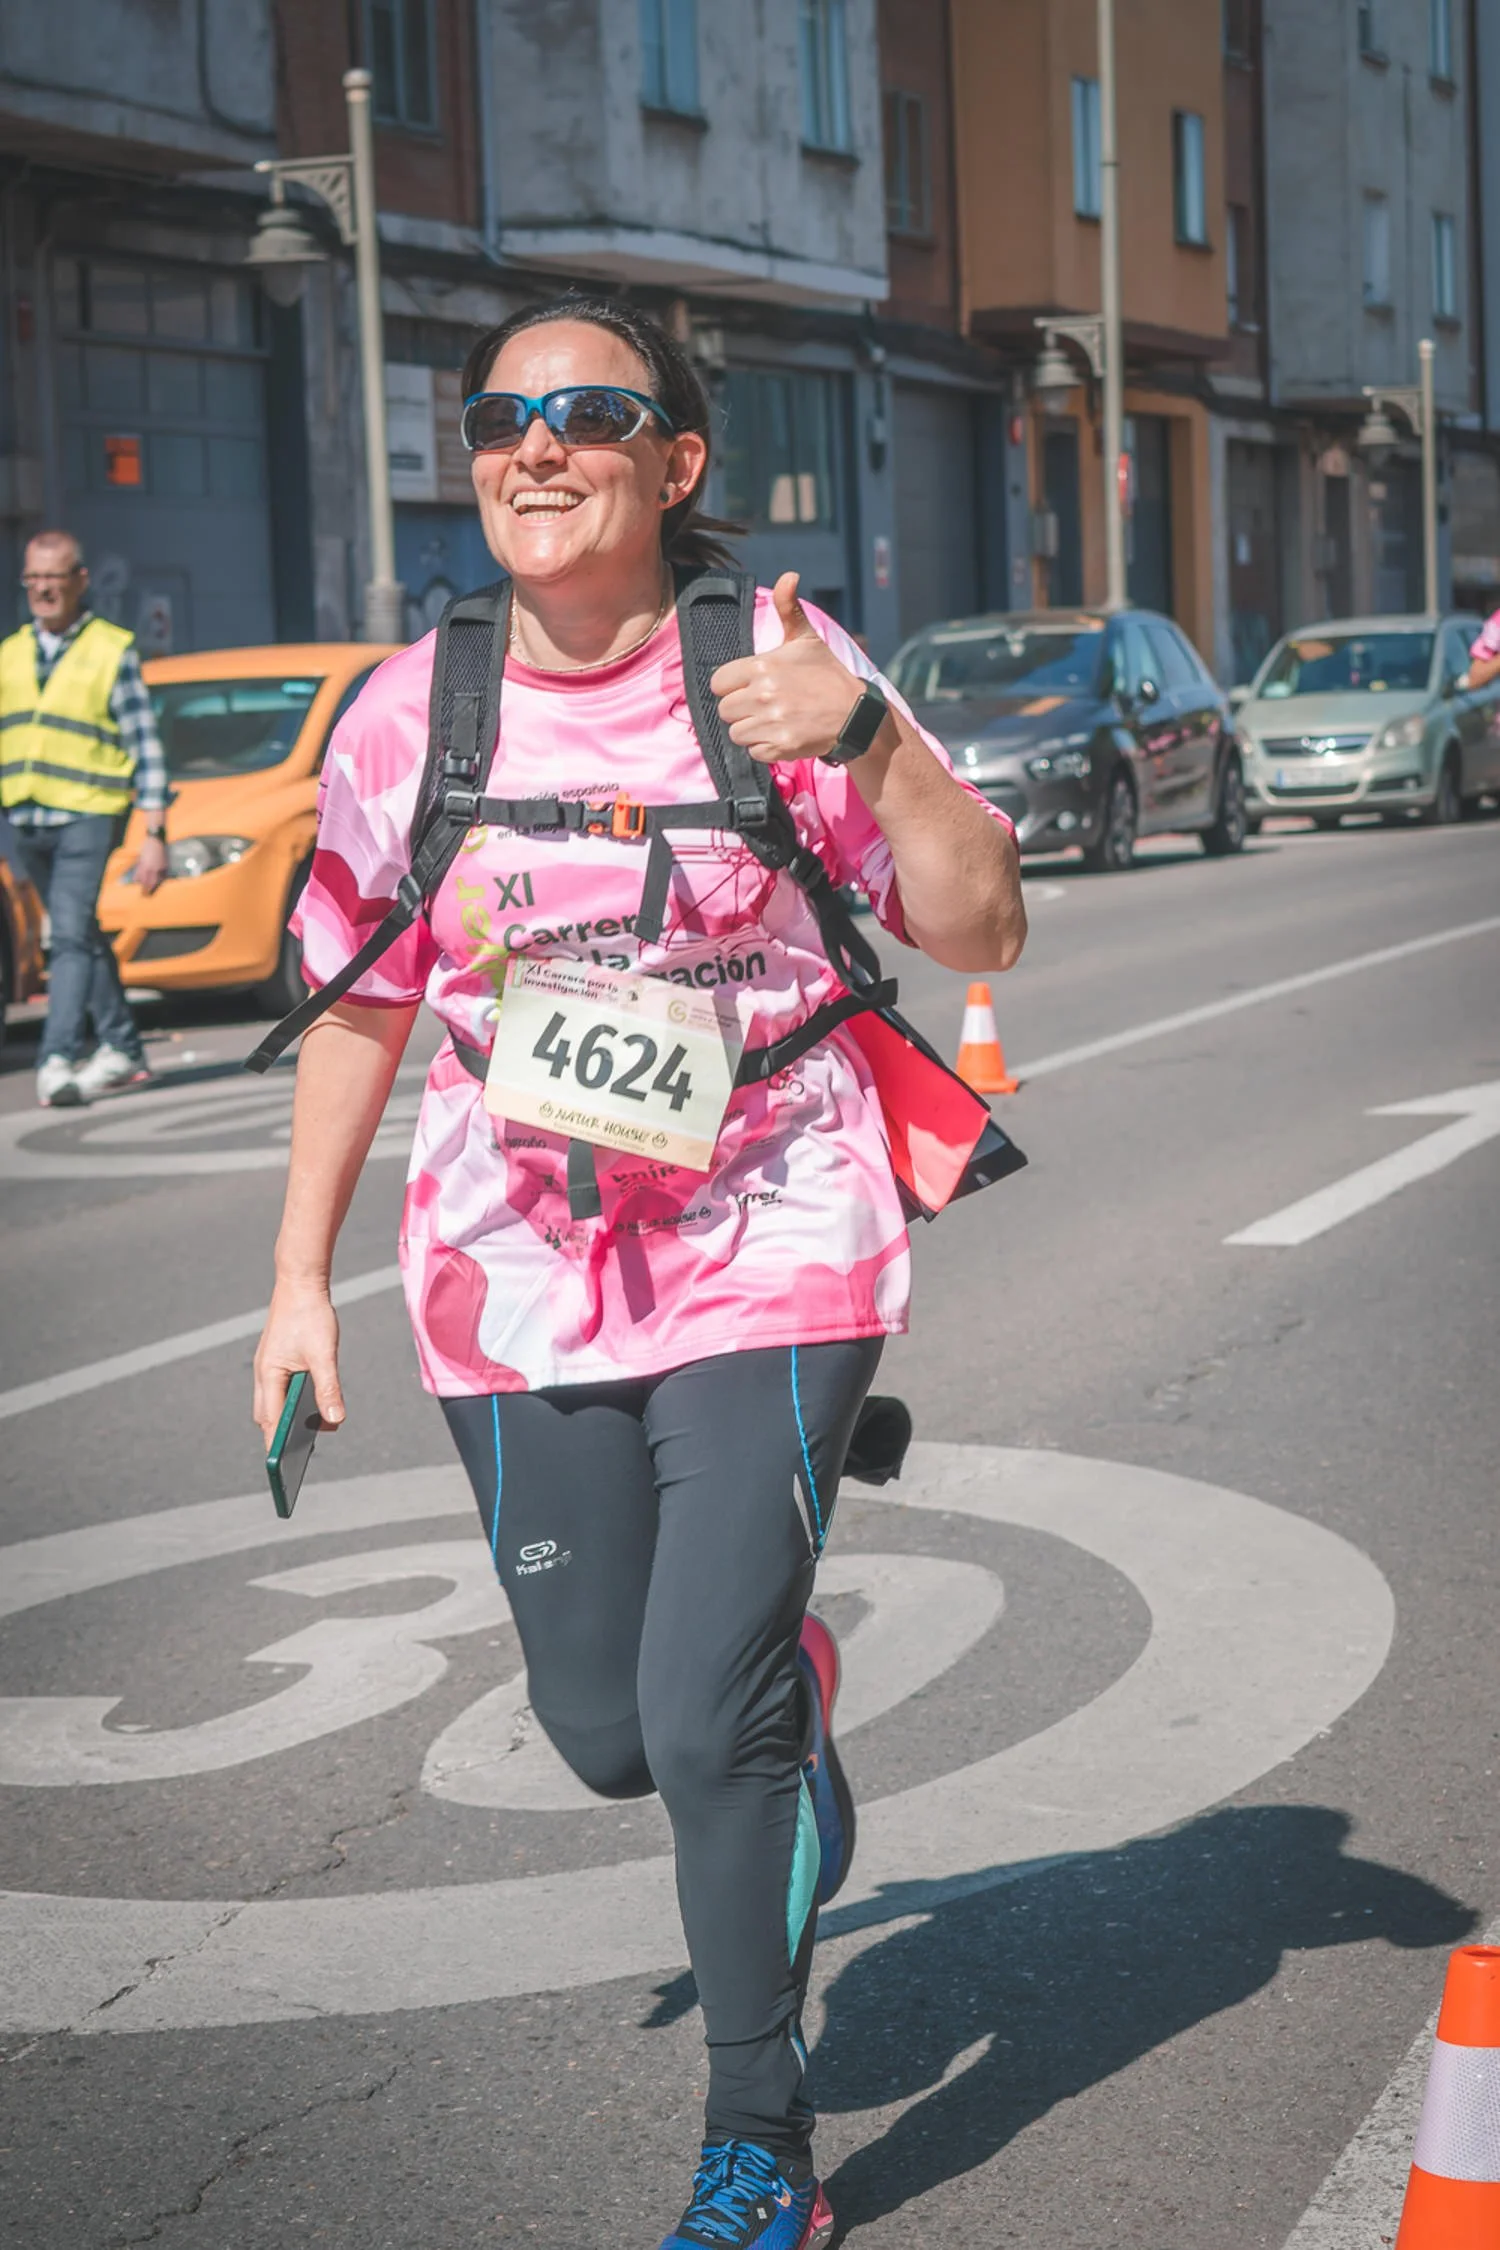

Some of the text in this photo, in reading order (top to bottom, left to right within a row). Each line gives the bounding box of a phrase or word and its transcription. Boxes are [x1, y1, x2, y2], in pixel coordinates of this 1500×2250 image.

[562, 781, 620, 800] española
[497, 829, 513, 840] en
[493, 872, 535, 912] XI
[503, 913, 638, 952] Carrer
[526, 964, 543, 976] XI
[543, 968, 587, 985] Carrera
[531, 1011, 693, 1112] 4624
[555, 1108, 600, 1129] NATUR
